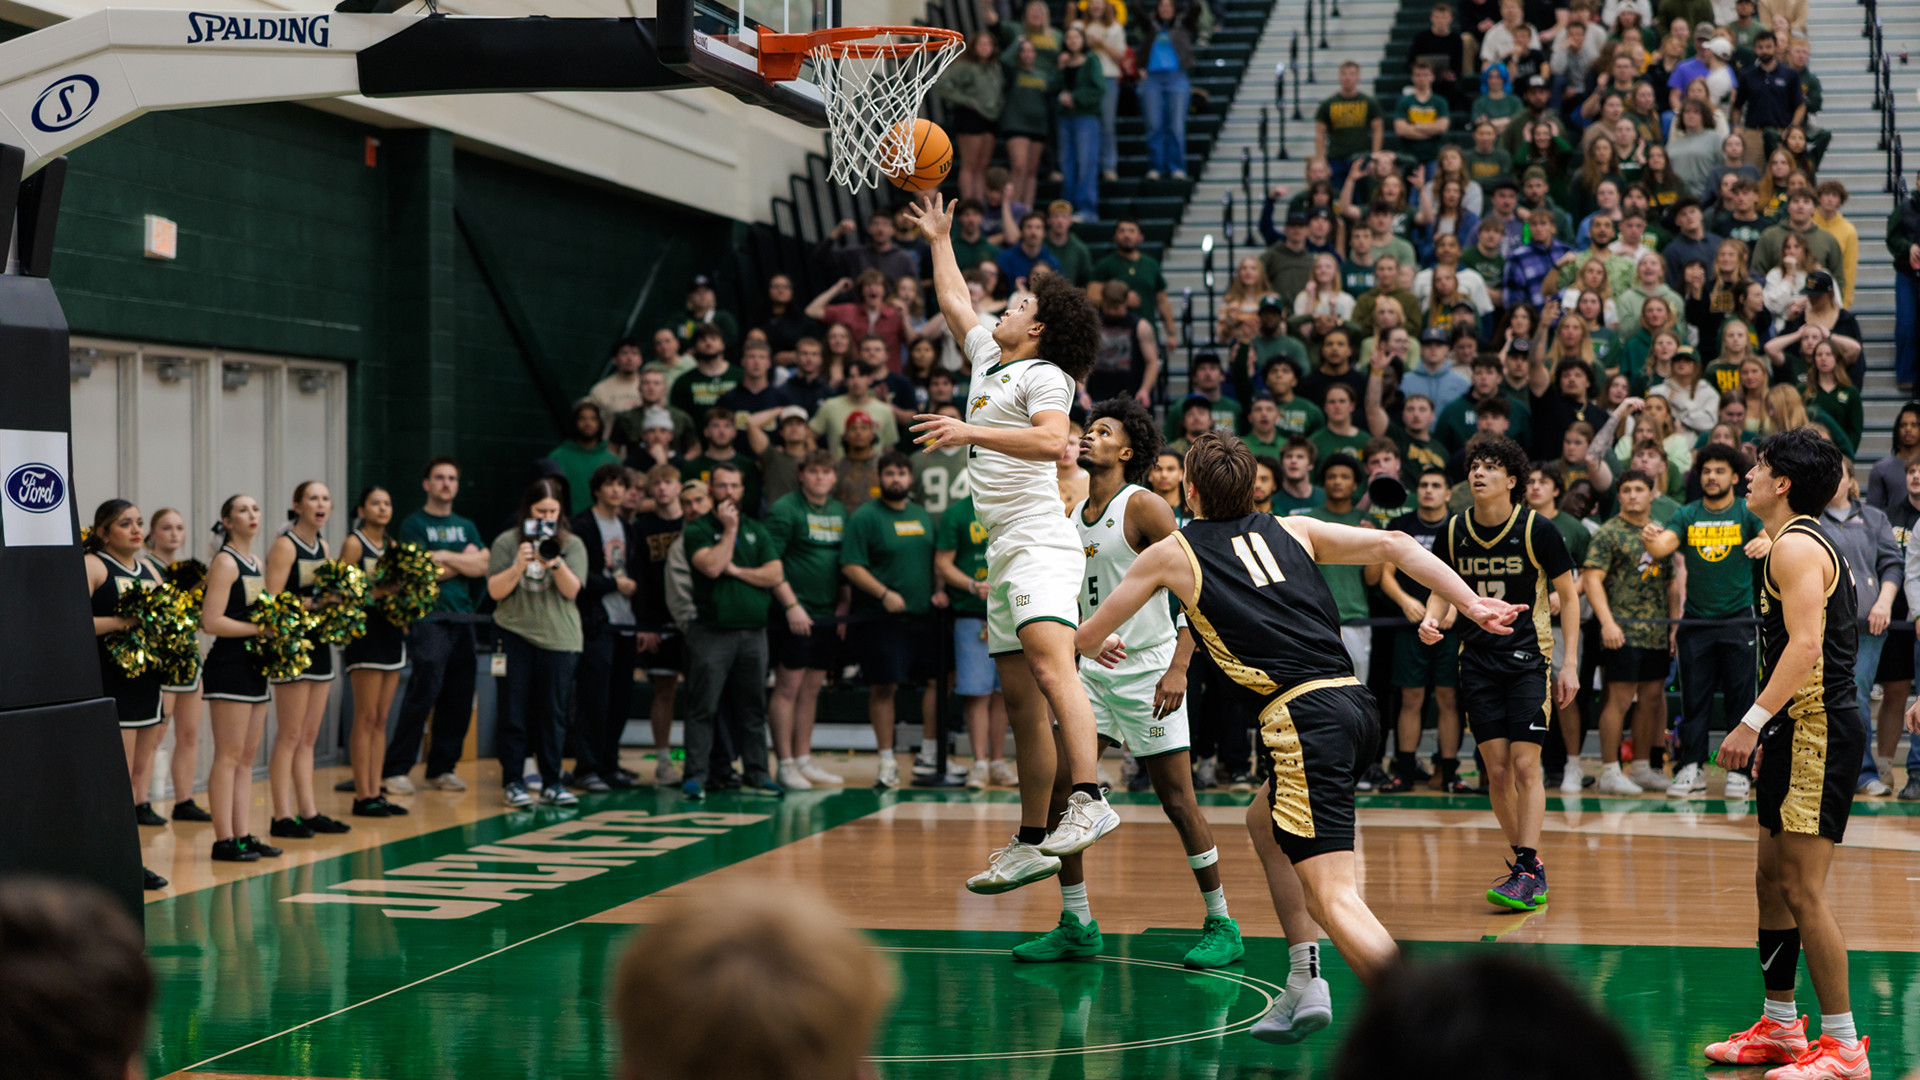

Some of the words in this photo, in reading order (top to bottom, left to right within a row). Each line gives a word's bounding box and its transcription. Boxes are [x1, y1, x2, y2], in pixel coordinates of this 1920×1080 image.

[187, 11, 330, 48] SPALDING
[18, 470, 56, 504] Ford
[922, 466, 970, 513] 94
[1230, 531, 1287, 588] 11
[1458, 556, 1523, 575] UCCS
[1016, 594, 1030, 607] BH
[1088, 576, 1098, 606] 5
[1149, 726, 1165, 738] BH
[278, 810, 772, 920] JACKETS
